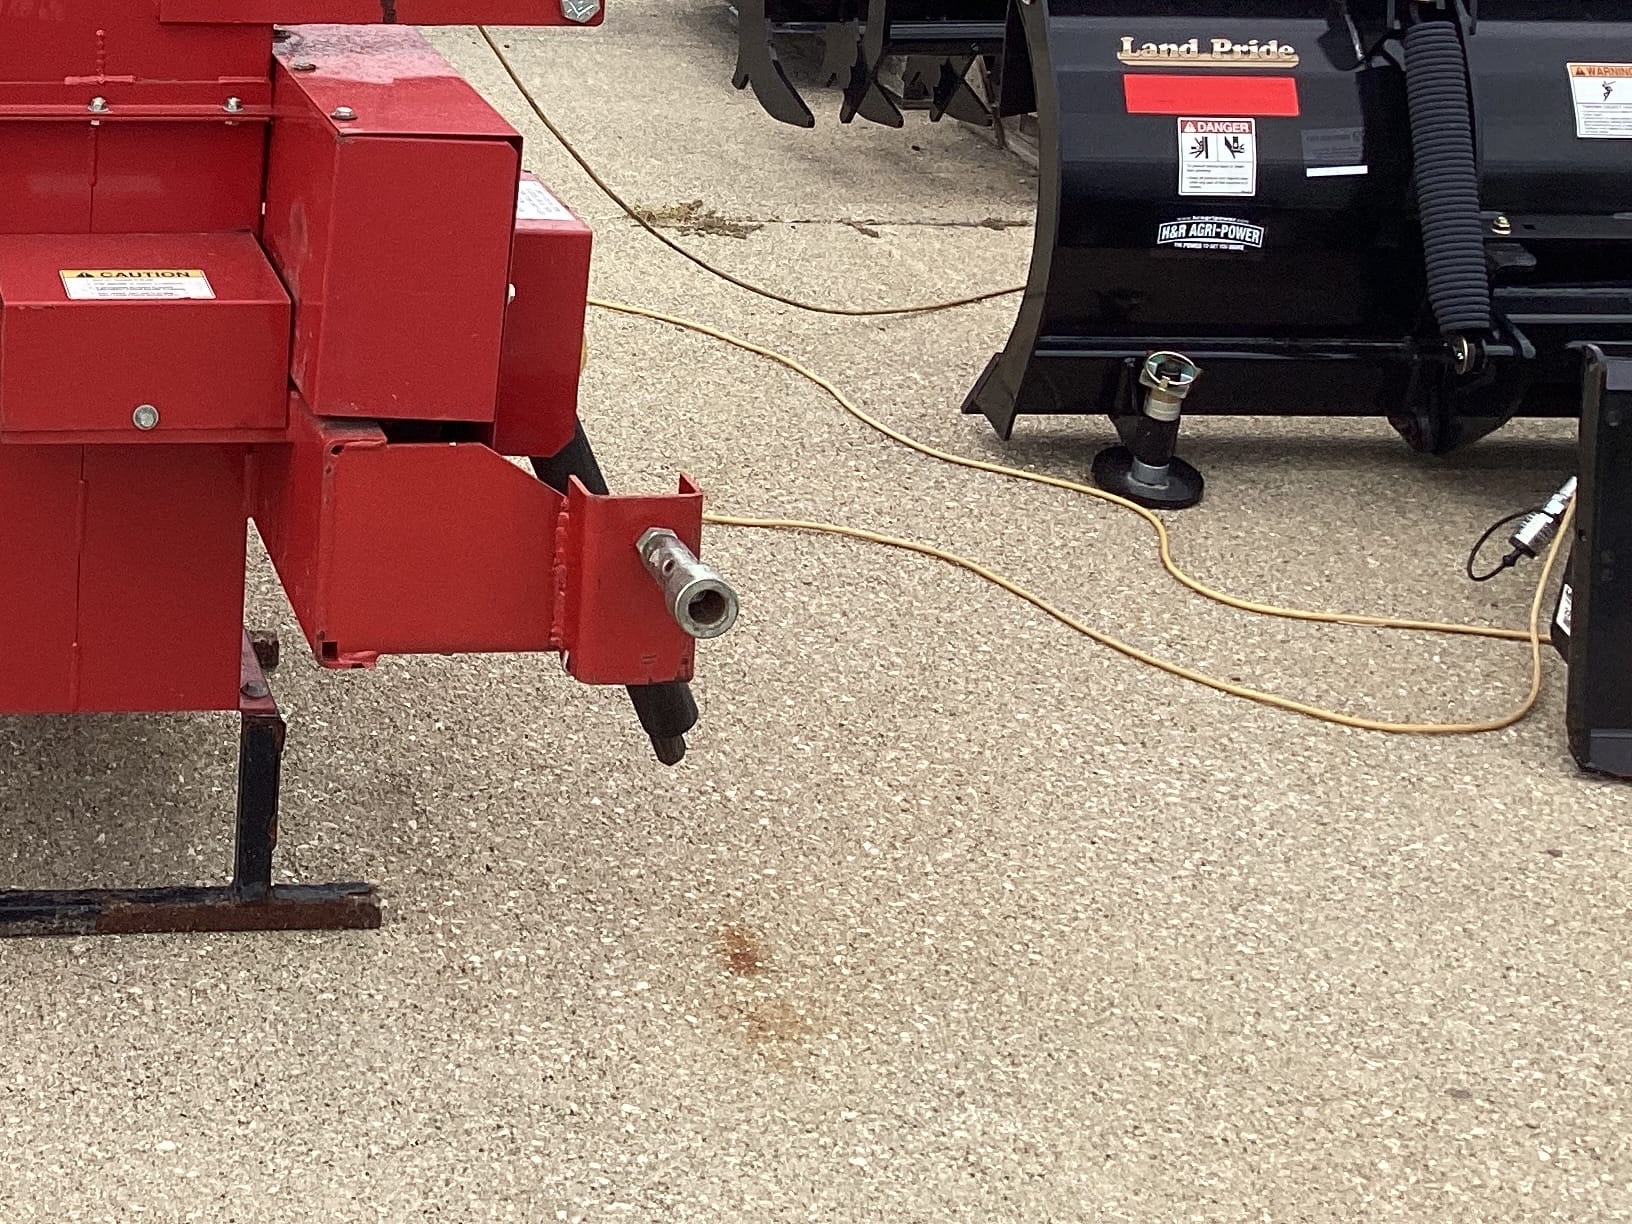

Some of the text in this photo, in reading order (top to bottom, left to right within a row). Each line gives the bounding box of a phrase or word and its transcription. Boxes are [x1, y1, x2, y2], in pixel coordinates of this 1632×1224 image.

[1120, 36, 1295, 60] Land Pride
[1198, 122, 1249, 132] DANGER
[1162, 223, 1260, 243] H&R AGRI-POWER
